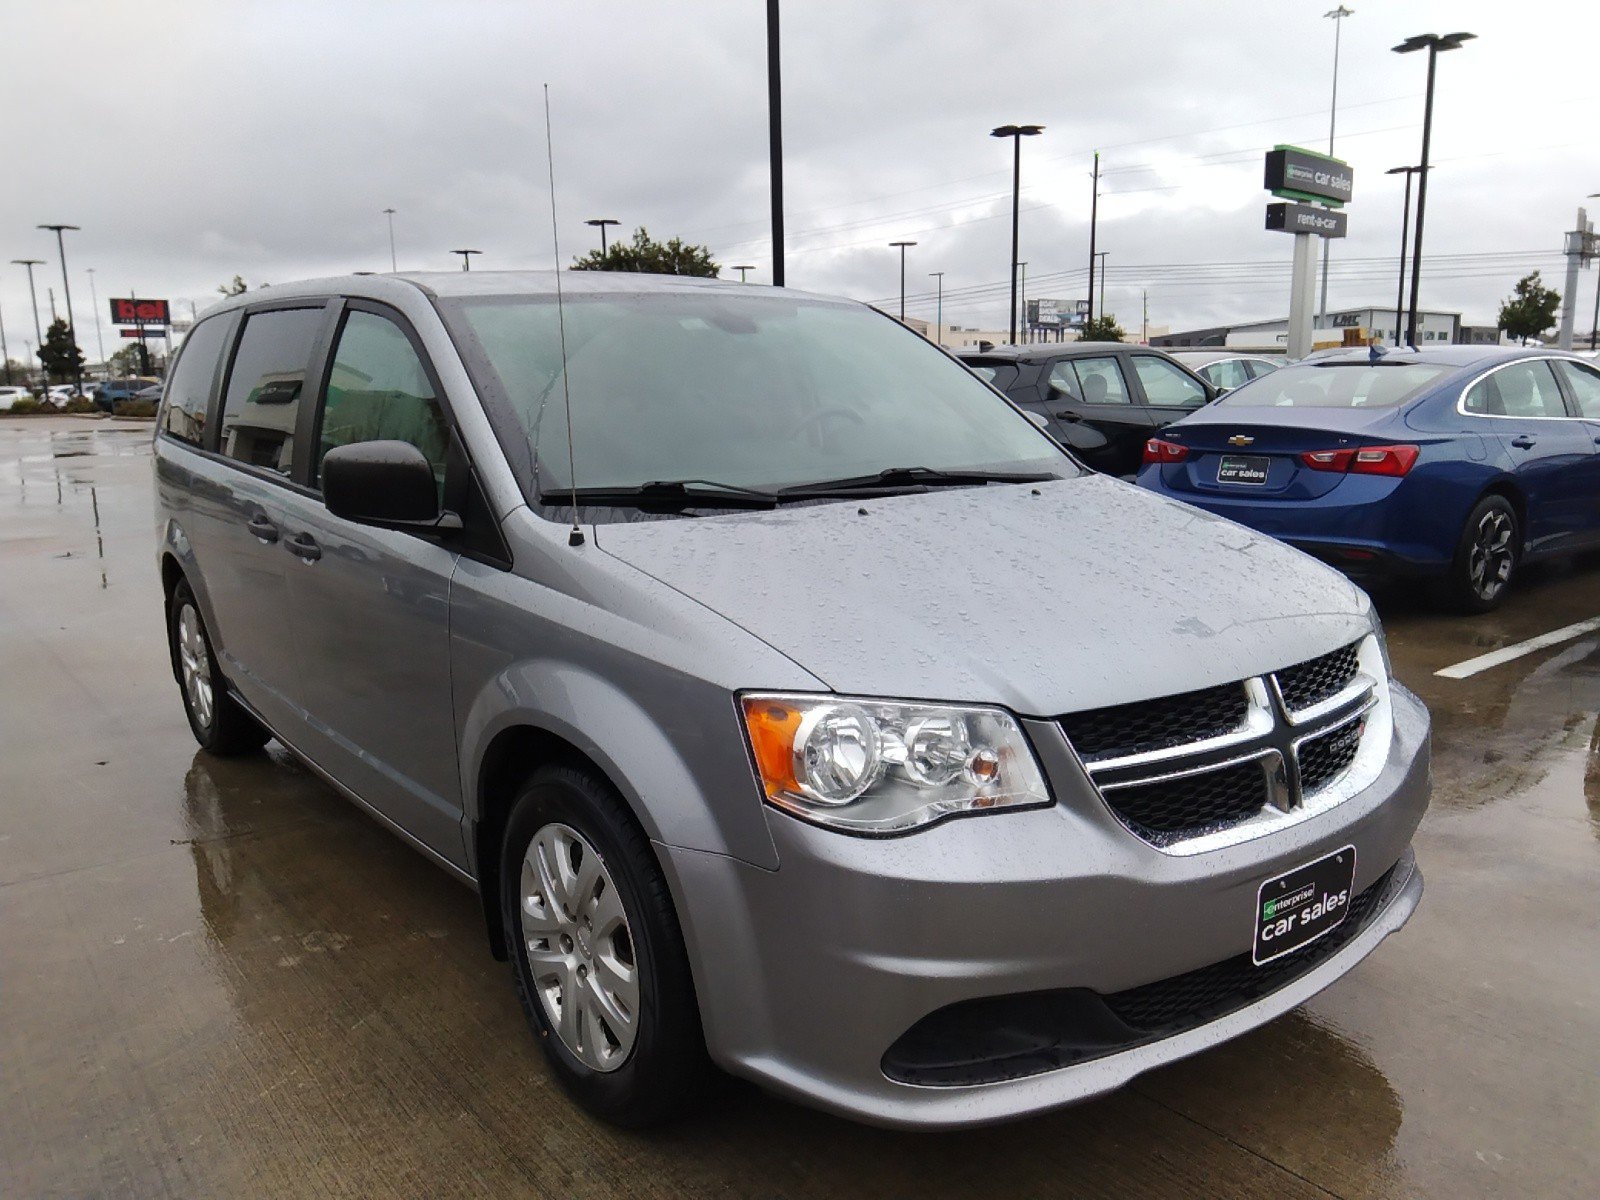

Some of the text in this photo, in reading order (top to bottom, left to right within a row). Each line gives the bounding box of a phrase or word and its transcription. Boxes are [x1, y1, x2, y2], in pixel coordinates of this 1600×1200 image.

[1315, 171, 1331, 185] car
[1331, 173, 1351, 191] sales
[1297, 213, 1337, 229] rent-a-car
[117, 299, 165, 319] bel
[1238, 469, 1264, 478] sales
[1265, 888, 1314, 916] enterprise
[1261, 889, 1348, 942] car sales
